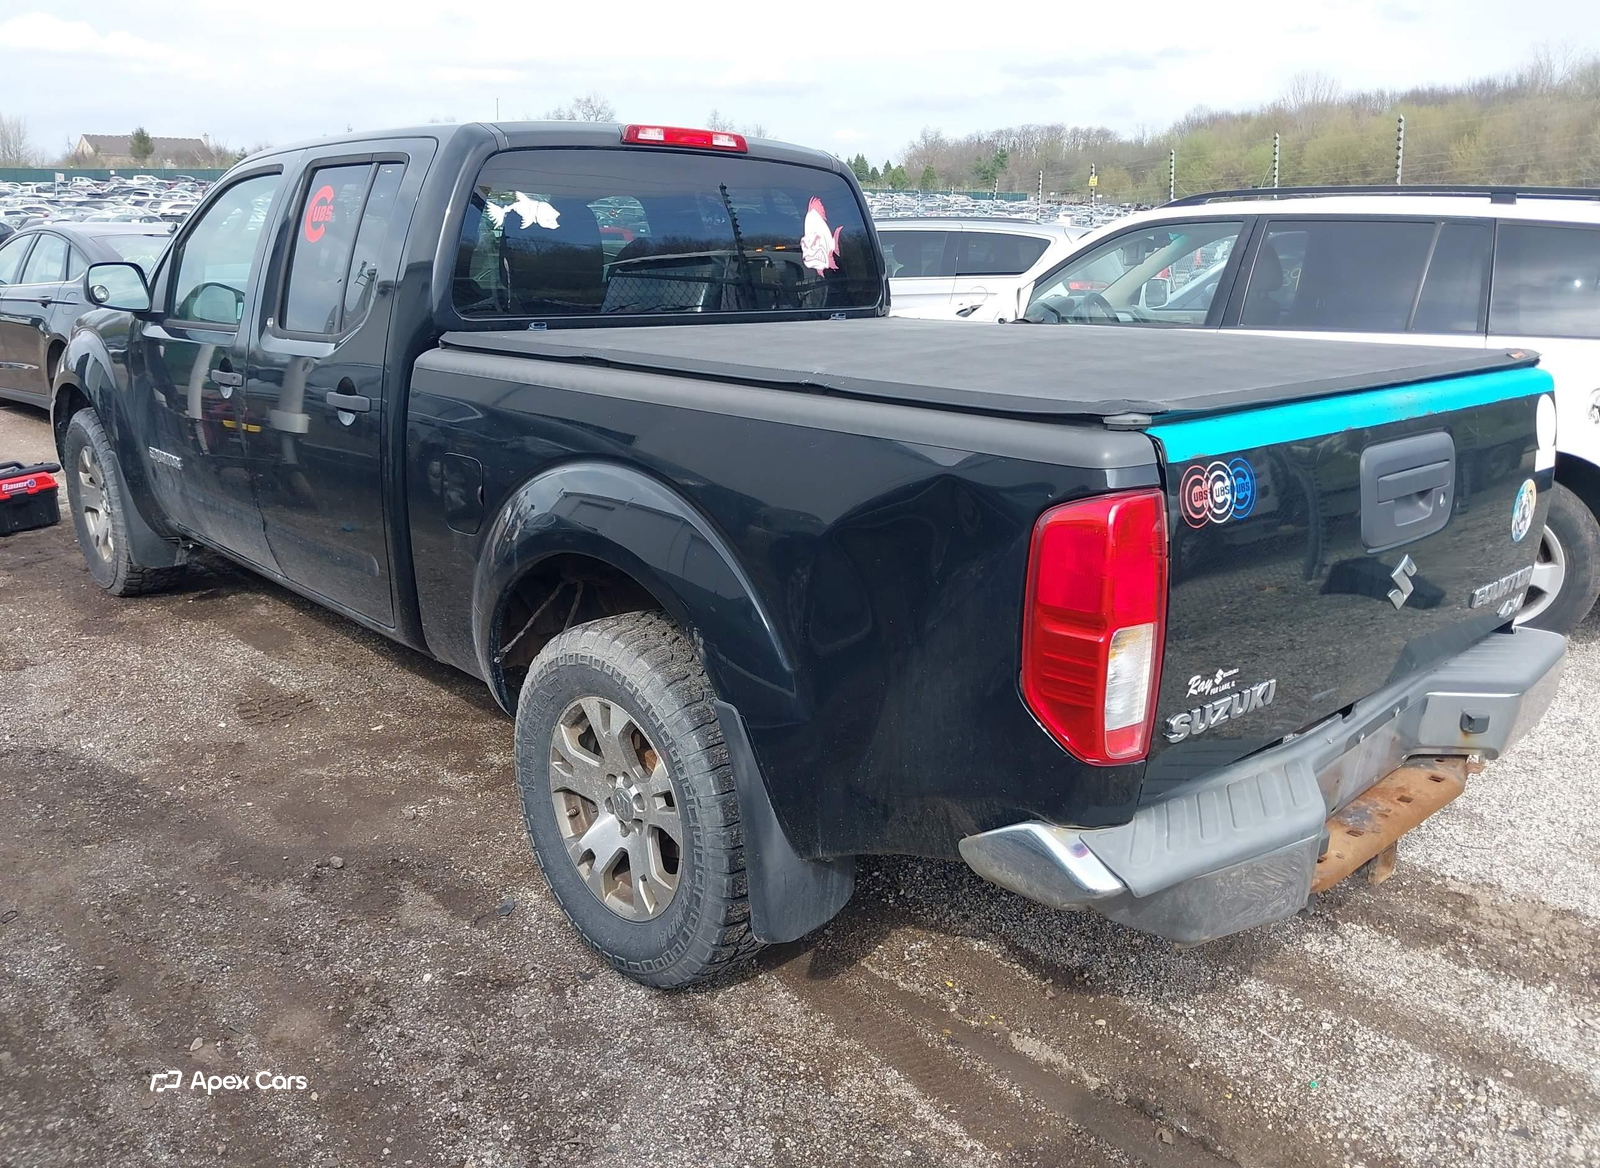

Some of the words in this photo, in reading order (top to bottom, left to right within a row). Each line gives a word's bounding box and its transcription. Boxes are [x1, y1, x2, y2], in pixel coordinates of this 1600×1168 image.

[304, 184, 335, 243] CUBS
[2, 481, 29, 491] Bauer
[1185, 674, 1213, 698] Ray
[1162, 678, 1277, 744] SUZUKI
